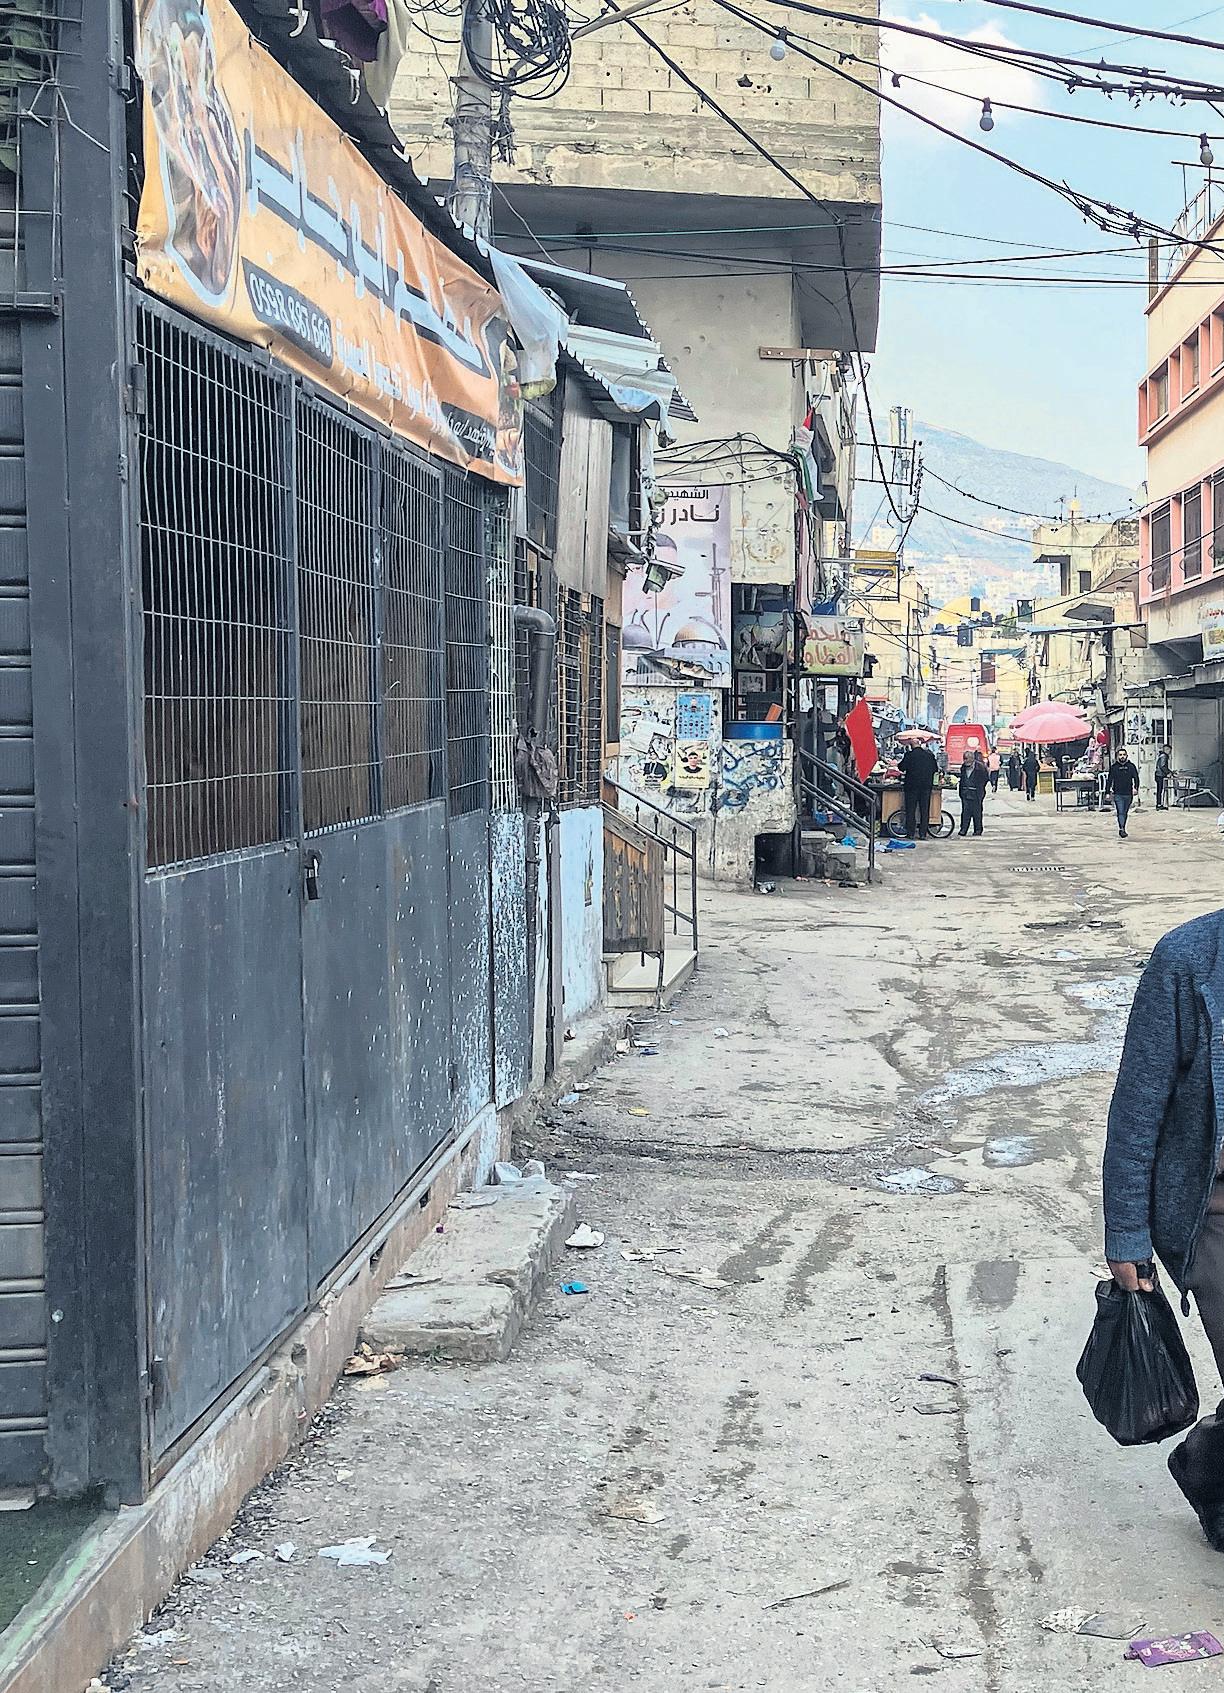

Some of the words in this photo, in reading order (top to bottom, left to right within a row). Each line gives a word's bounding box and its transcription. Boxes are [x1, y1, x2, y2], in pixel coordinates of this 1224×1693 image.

[249, 271, 292, 328] 0598
[287, 294, 312, 342] 887
[311, 312, 332, 356] 668
[668, 487, 709, 501] الشهيد
[670, 504, 720, 526] نادر
